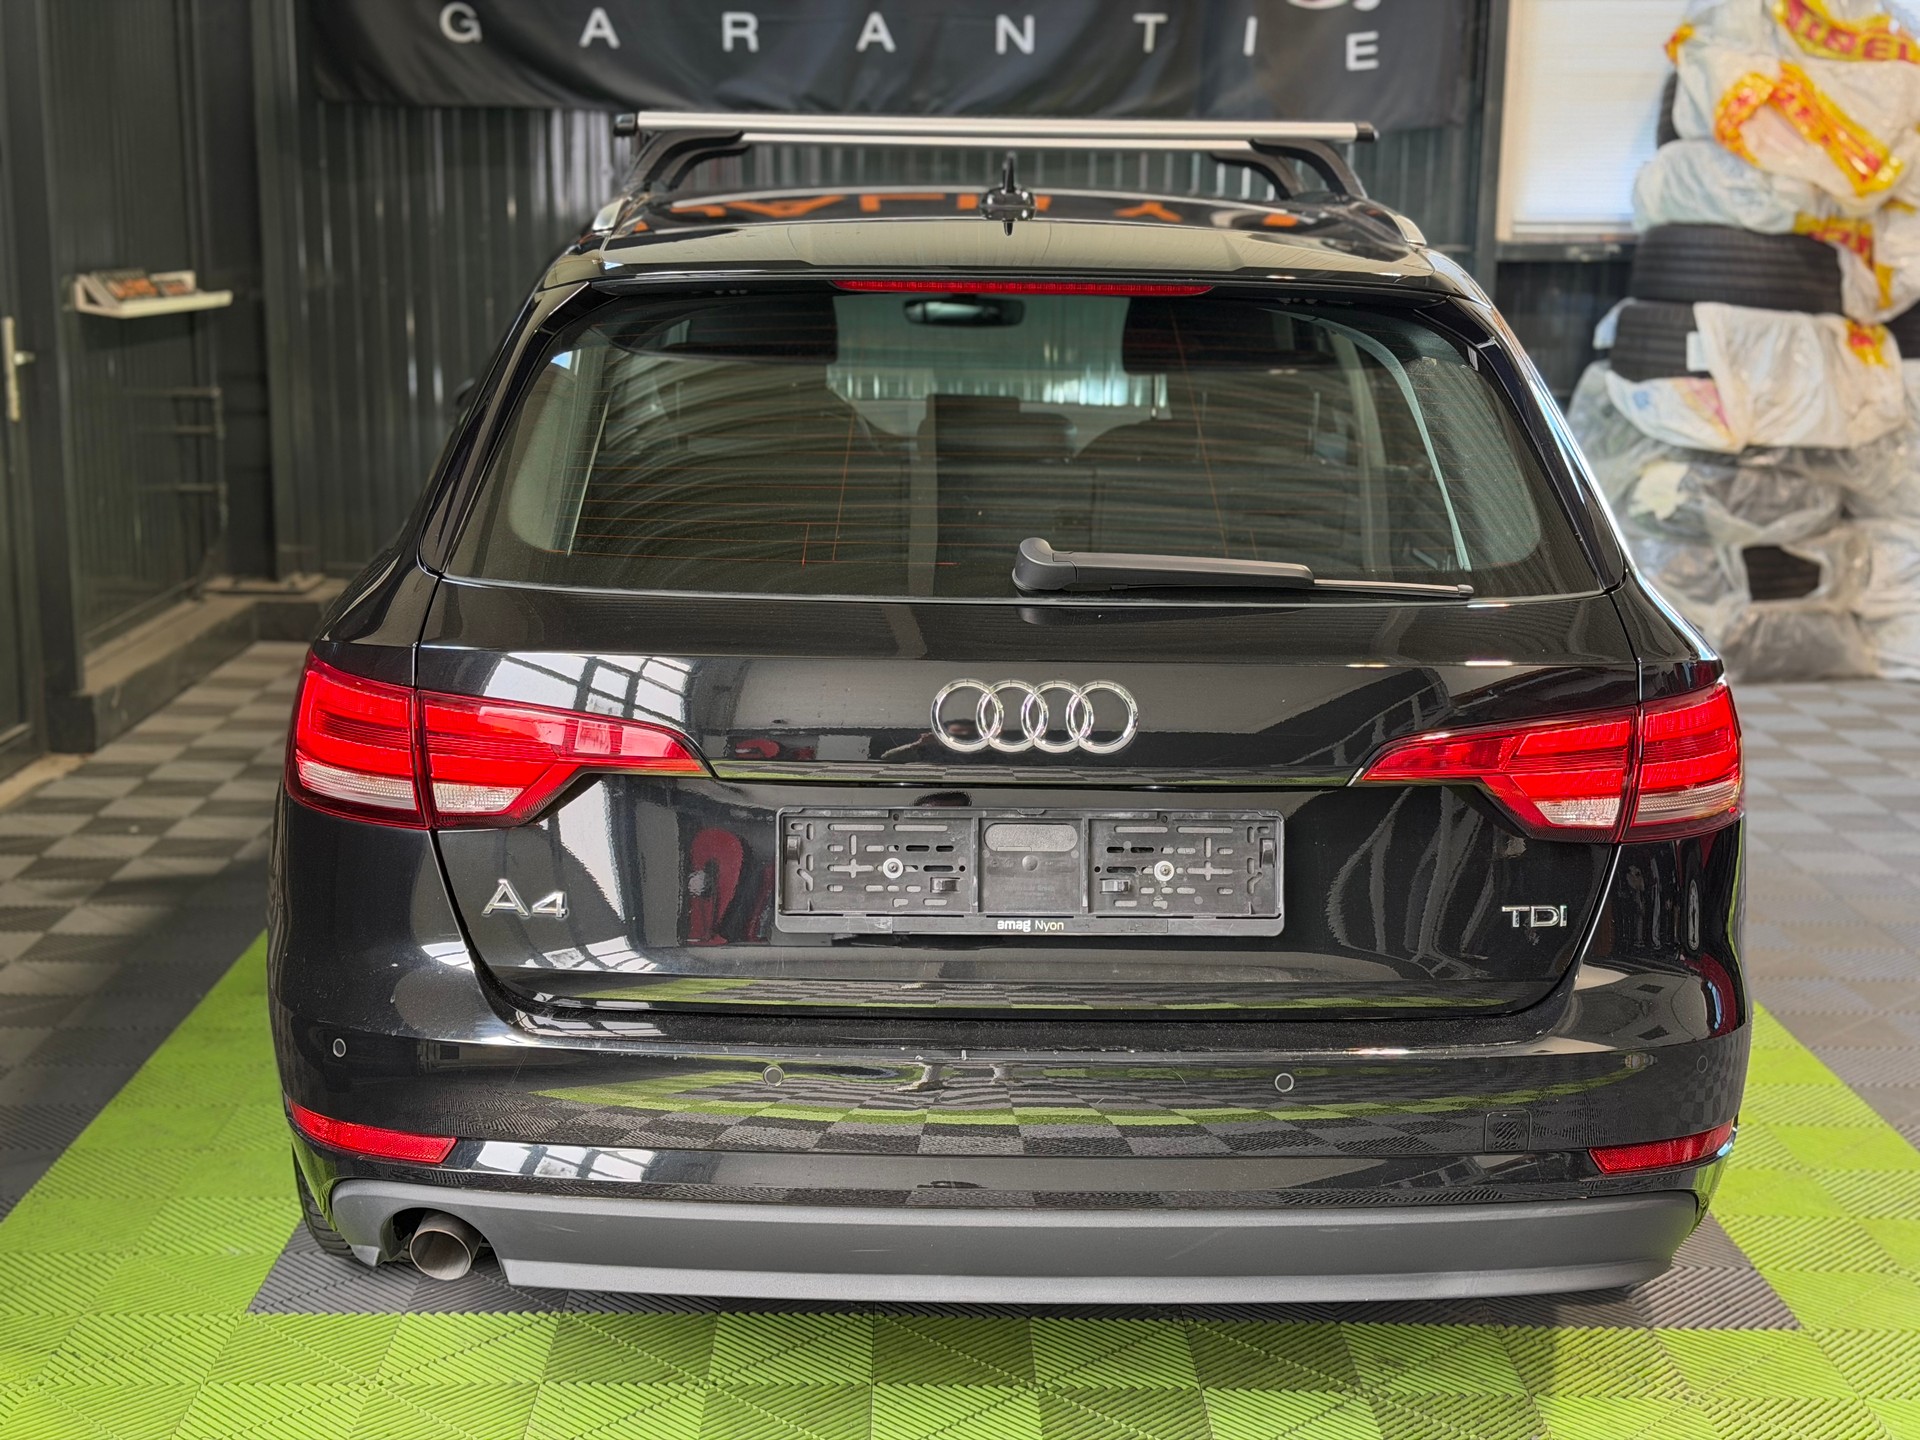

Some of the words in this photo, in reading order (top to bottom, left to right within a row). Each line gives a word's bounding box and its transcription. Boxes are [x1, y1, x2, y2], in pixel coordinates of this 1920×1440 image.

[440, 2, 1379, 71] GARANTIE
[482, 878, 569, 919] A4
[997, 920, 1031, 932] amag
[1035, 920, 1064, 932] Nyon
[1501, 905, 1567, 928] TDI
